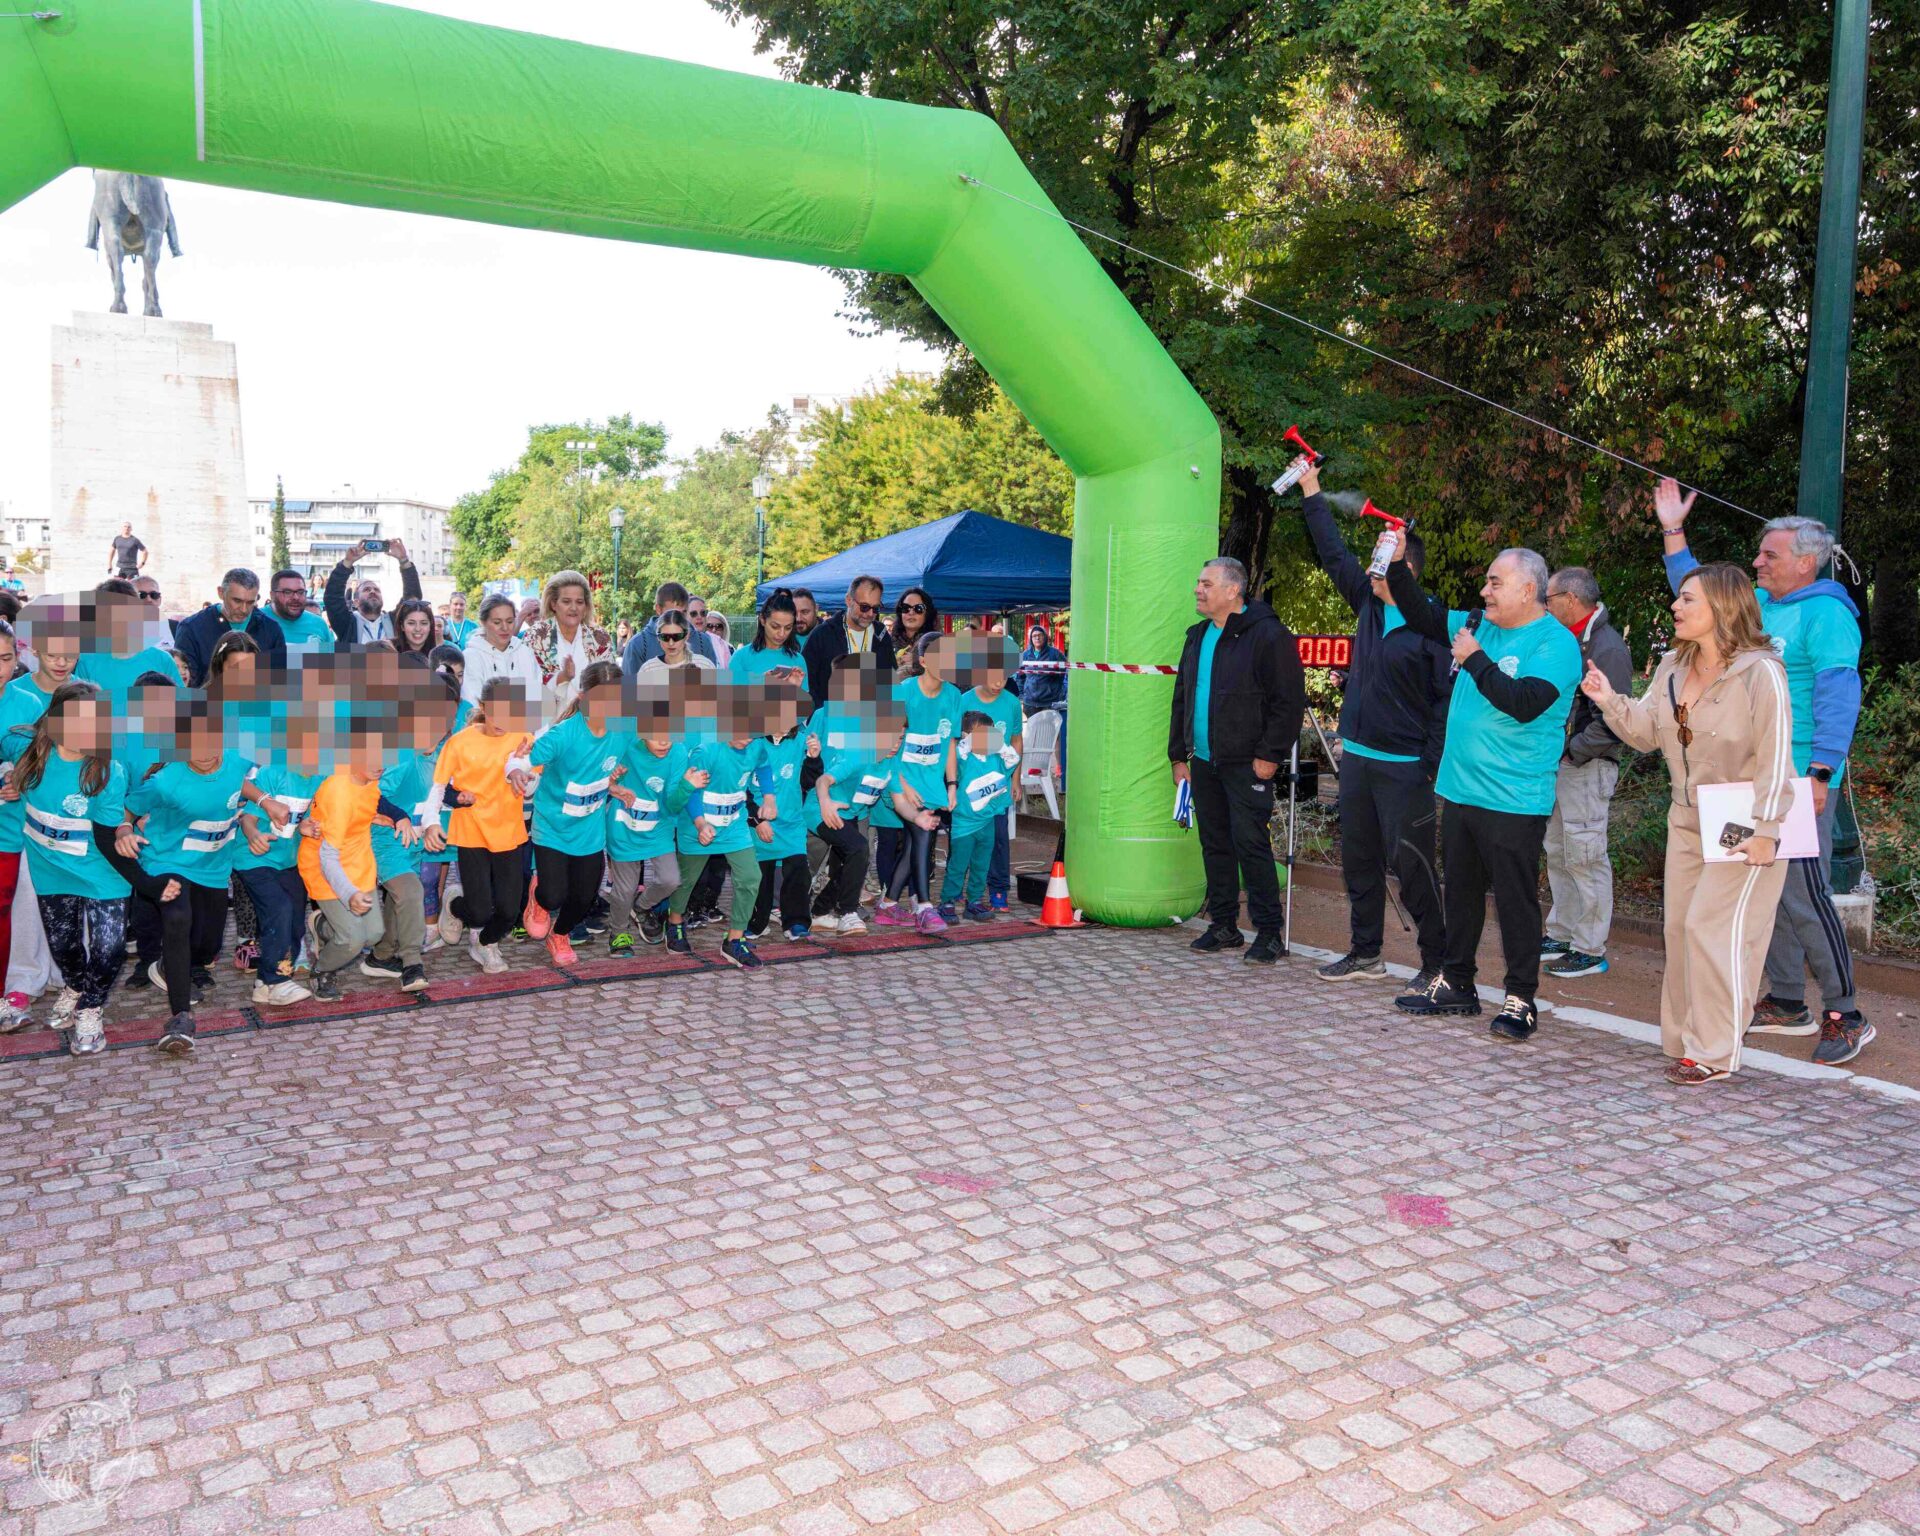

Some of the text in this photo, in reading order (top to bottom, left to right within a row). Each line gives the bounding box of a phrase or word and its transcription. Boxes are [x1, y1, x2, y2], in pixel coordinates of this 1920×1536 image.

[915, 744, 934, 756] 269
[979, 783, 998, 798] 202
[716, 804, 736, 816] 118
[39, 824, 70, 841] 134
